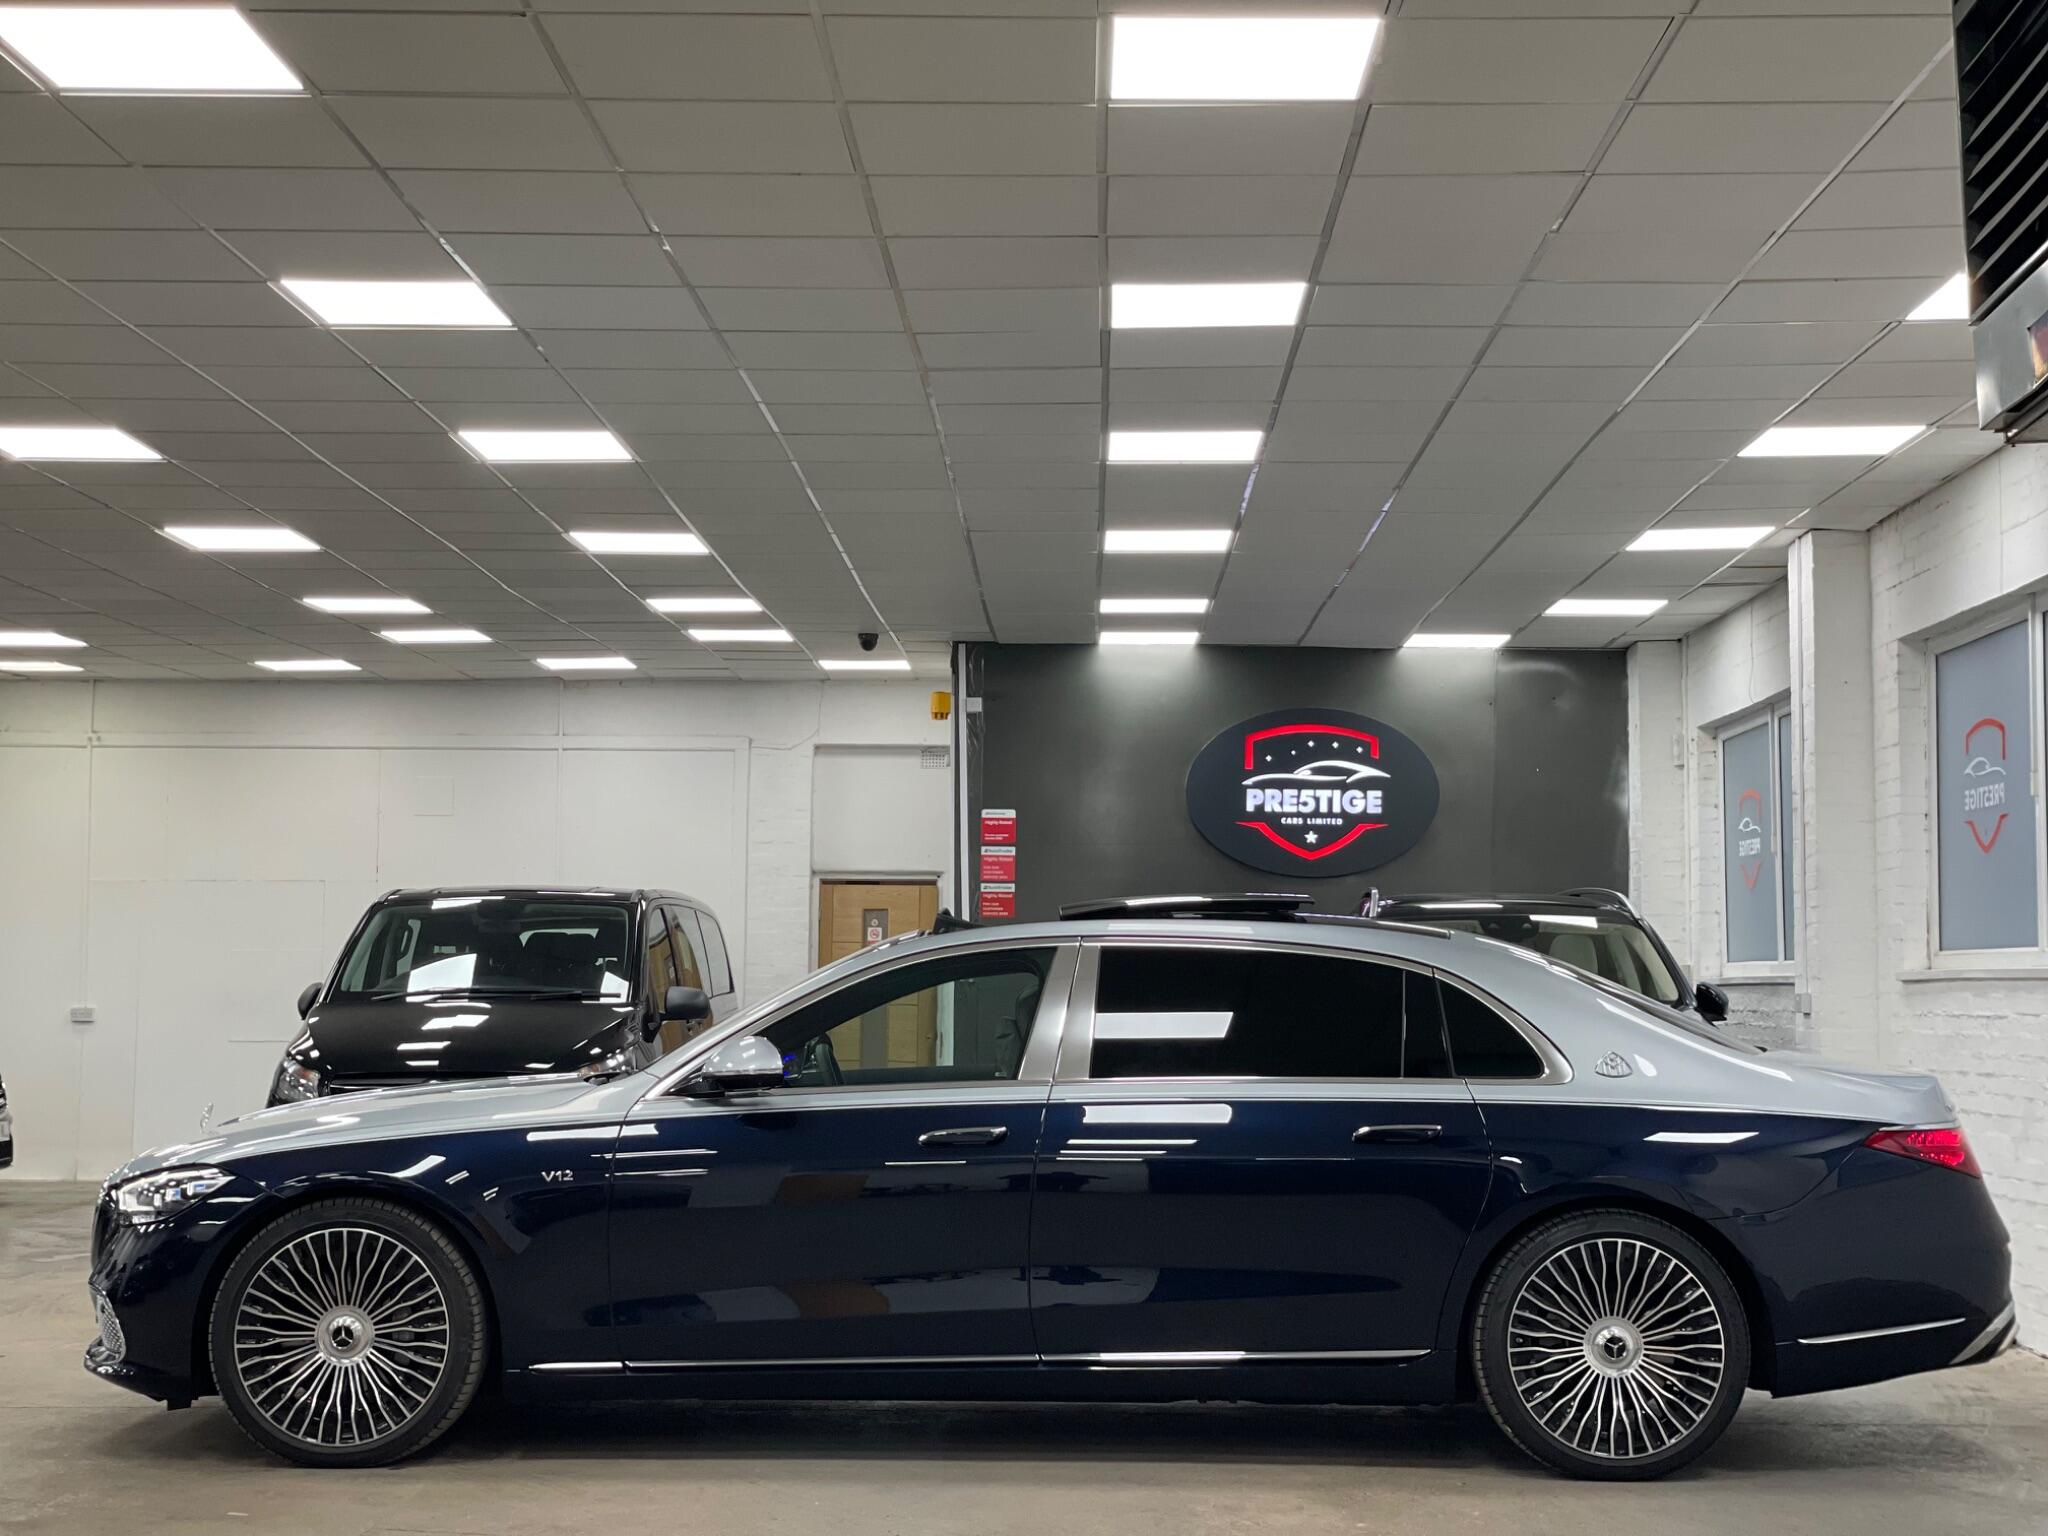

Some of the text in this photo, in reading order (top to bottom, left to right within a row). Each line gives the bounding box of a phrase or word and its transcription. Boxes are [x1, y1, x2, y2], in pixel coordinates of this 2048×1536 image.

[1280, 817, 1344, 826] CARS LIMITED
[541, 1169, 574, 1182] V12
